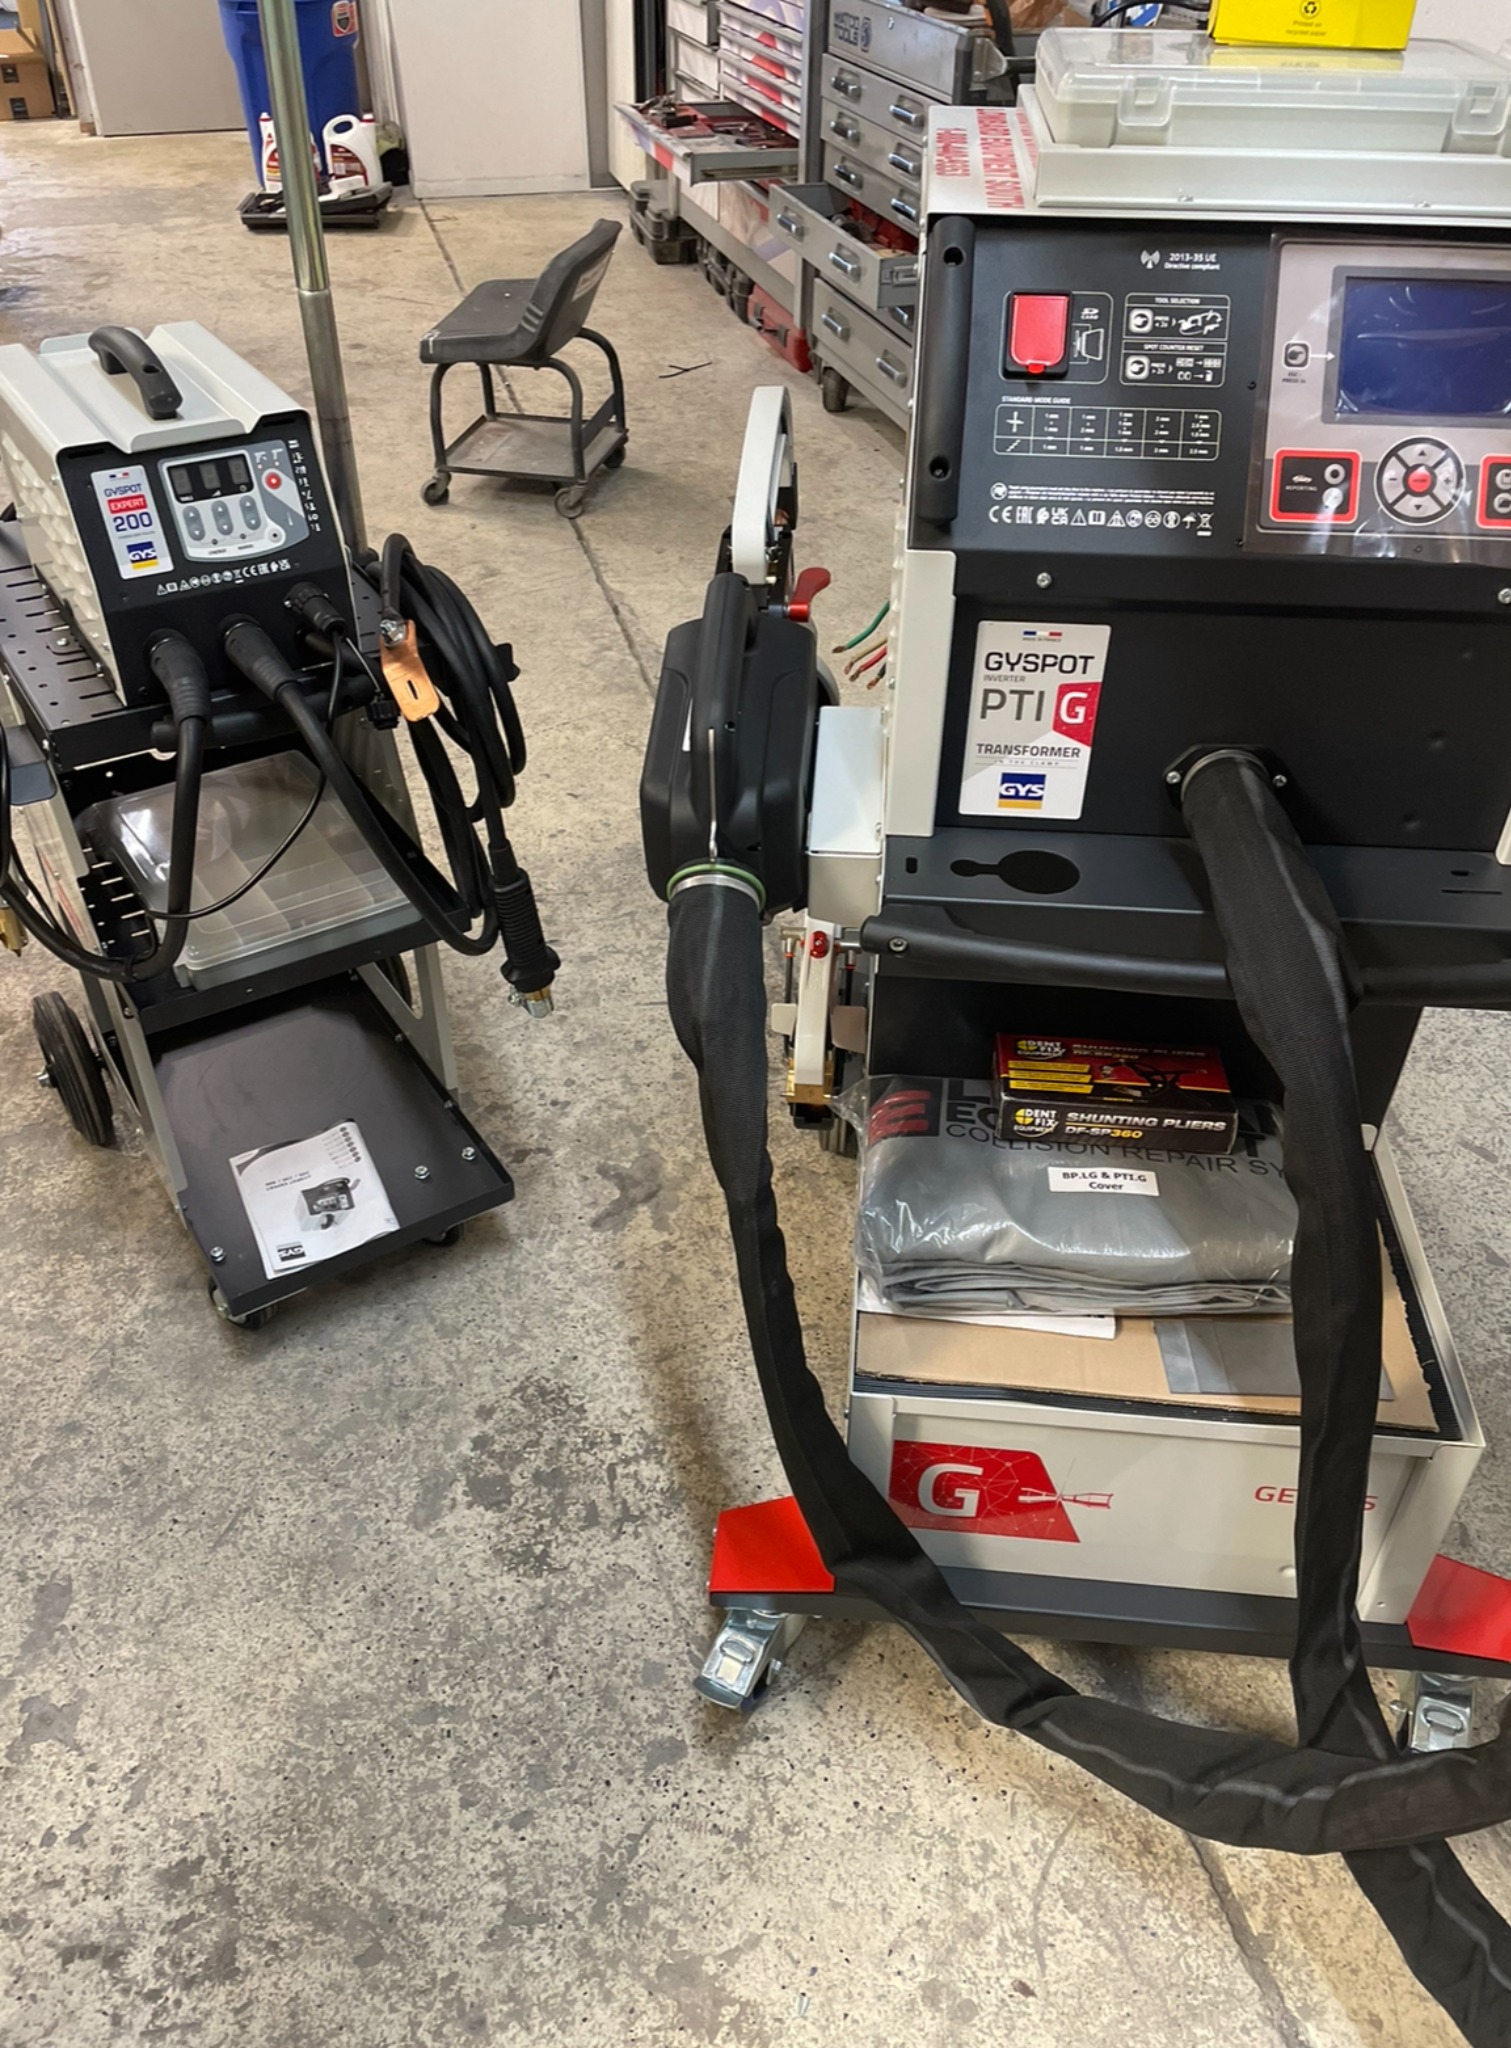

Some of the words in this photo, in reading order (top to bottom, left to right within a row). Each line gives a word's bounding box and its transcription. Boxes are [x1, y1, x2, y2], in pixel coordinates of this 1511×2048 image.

[980, 137, 1019, 178] EQUIPMENT
[985, 180, 1025, 208] SOUTH
[1169, 253, 1203, 262] 2013-35
[104, 483, 142, 497] GYSPOT
[110, 497, 145, 512] EXPERT
[113, 511, 153, 532] 200
[129, 547, 157, 561] GYS
[985, 652, 1095, 675] GYSPOT
[983, 674, 1026, 683] INVERTER
[979, 688, 1045, 722] PTI
[1059, 691, 1088, 724] G
[976, 743, 1081, 758] TRANSFORMER
[1000, 783, 1045, 797] GYS
[1027, 1040, 1062, 1048] DENT
[1072, 1044, 1149, 1053] SHUNTING
[1026, 1108, 1057, 1118] DENT
[1034, 1117, 1055, 1127] FIX
[1066, 1112, 1157, 1127] SHUNTING
[1162, 1118, 1227, 1131] PLIERS
[1065, 1126, 1143, 1139] DF-SP360
[1101, 1171, 1111, 1179] &
[1088, 1181, 1124, 1190] Cover
[917, 1462, 984, 1518] G
